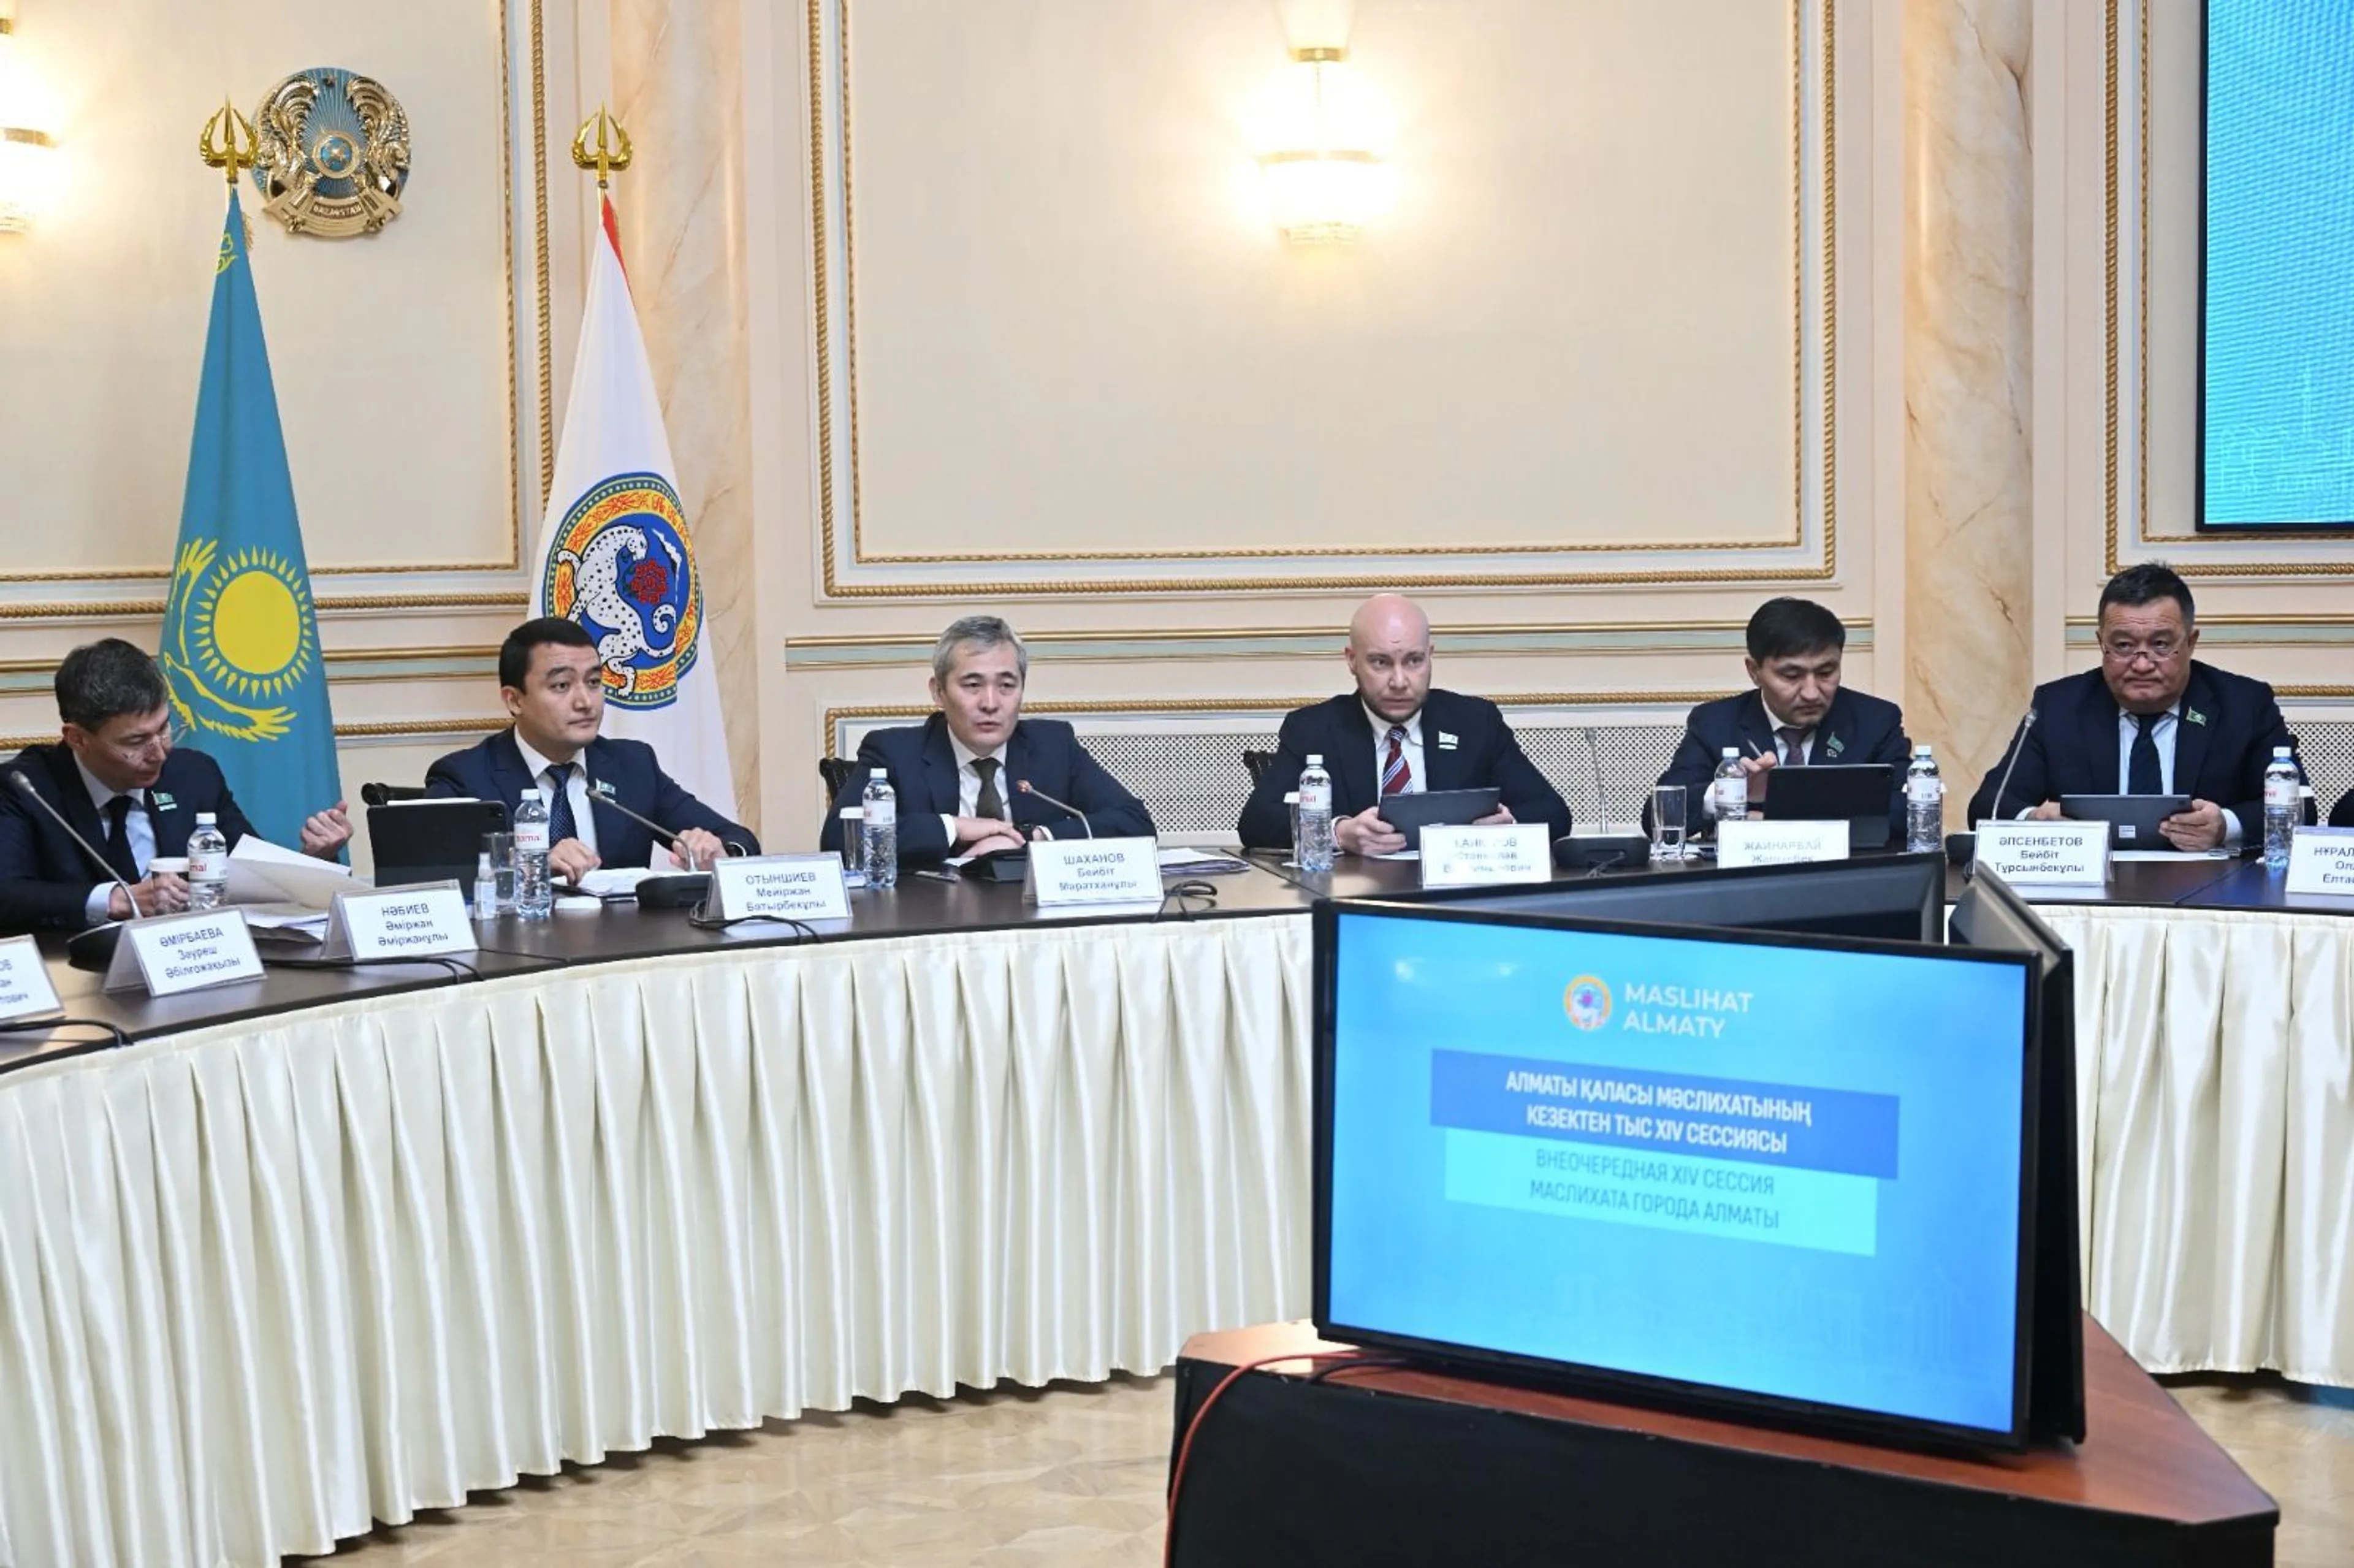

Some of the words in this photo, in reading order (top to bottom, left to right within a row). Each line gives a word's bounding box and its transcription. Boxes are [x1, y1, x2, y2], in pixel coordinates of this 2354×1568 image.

[1999, 837, 2083, 846] ӘПСЕНБЕТОВ
[2021, 850, 2059, 859] Бейбіт
[1064, 853, 1125, 865] ШАХАНОВ
[745, 872, 817, 885] ОТЫНШИЕВ
[381, 903, 430, 916] НӘБИЕВ
[1625, 982, 1754, 1013] MASLIHAT
[1623, 1010, 1726, 1038] ALMATY
[1506, 1071, 1578, 1098] АЛМАТЫ
[1580, 1078, 1654, 1106] ҚАЛАСЫ
[1656, 1086, 1812, 1128] МӘСЛИХАТЫНЫҢ
[1526, 1103, 1611, 1133] КЕЗЕКТЕН
[1614, 1113, 1652, 1139] ТЫС
[1655, 1119, 1684, 1142] XIV
[1687, 1121, 1787, 1154] СЕССИЯСЫ
[1536, 1147, 1667, 1182] ВНЕОЧЕРЕДНАЯ
[1671, 1165, 1699, 1186] XIV
[1703, 1168, 1774, 1196] СЕССИЯ
[1530, 1179, 1629, 1210] МАСЛИХАТА
[1634, 1192, 1700, 1220] ГОРОДА
[1704, 1201, 1779, 1229] АЛМАТЫ
